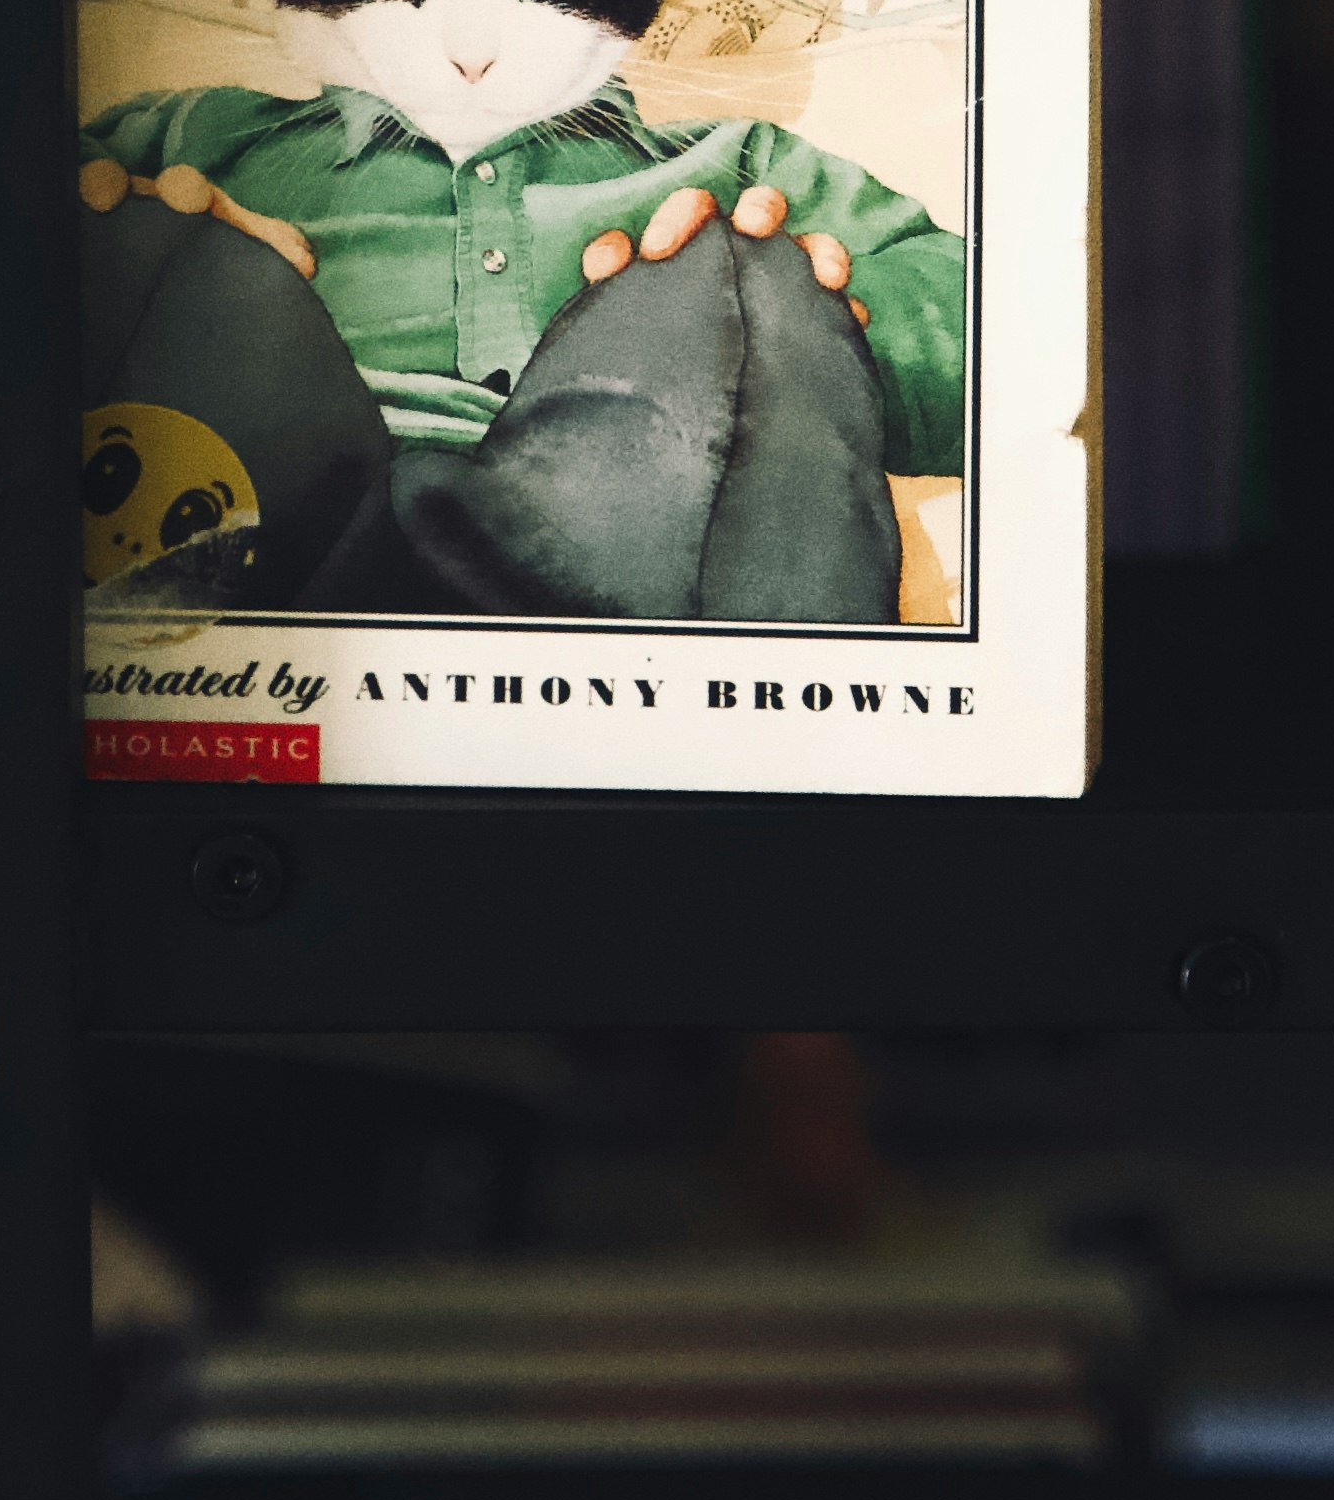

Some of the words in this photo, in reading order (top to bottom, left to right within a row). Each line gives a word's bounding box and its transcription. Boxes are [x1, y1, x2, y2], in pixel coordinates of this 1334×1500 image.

[268, 662, 330, 715] by
[356, 671, 664, 708] ANTHONY
[707, 680, 975, 716] BROWNE
